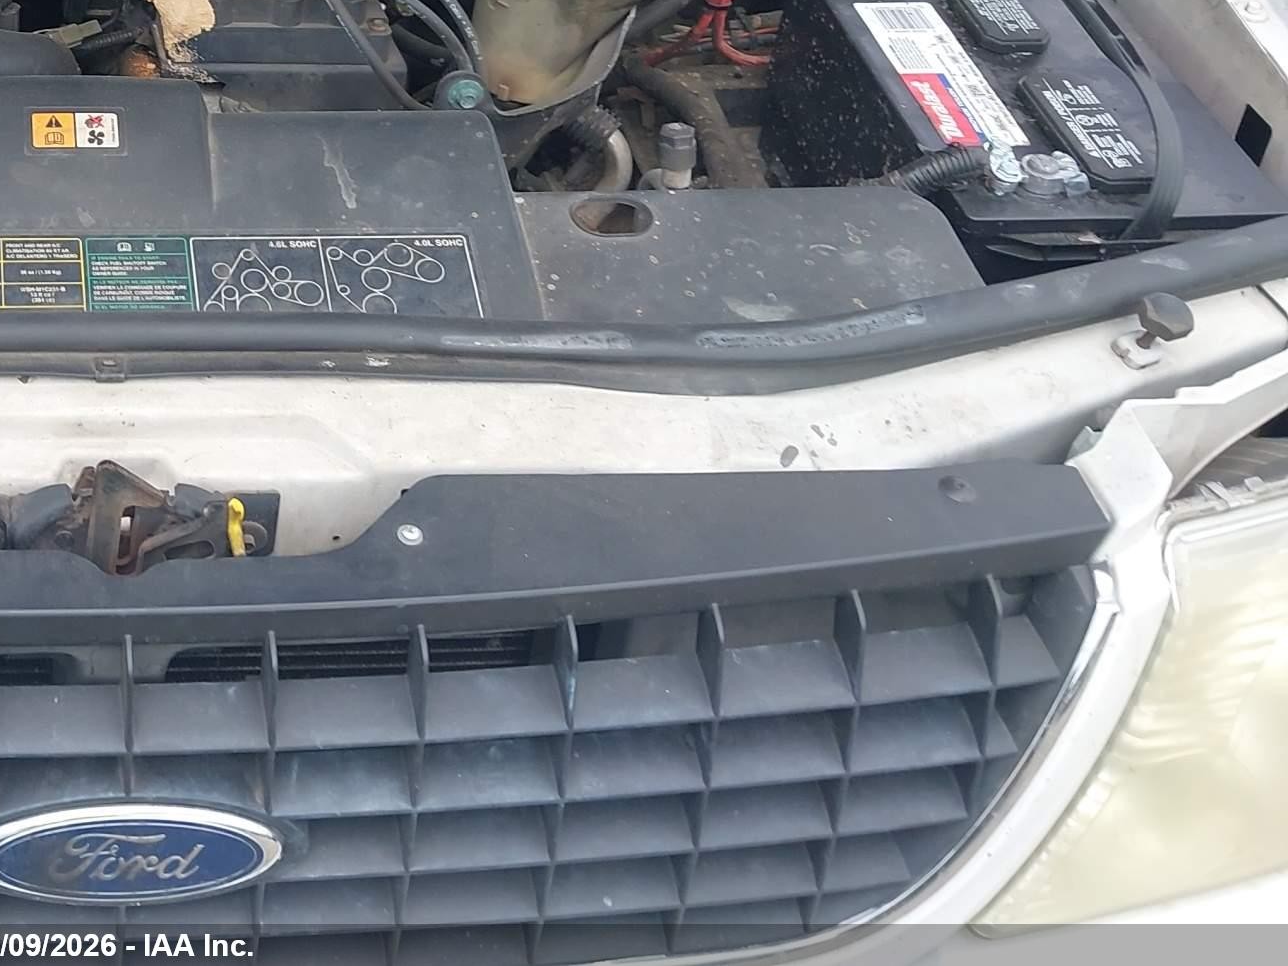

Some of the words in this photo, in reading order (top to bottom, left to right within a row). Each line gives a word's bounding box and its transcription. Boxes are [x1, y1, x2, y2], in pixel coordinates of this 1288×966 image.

[910, 80, 965, 138] Duralast
[290, 240, 317, 248] SOHC
[414, 239, 433, 247] 4.0L
[435, 239, 463, 247] SOHC
[48, 833, 206, 883] Ford
